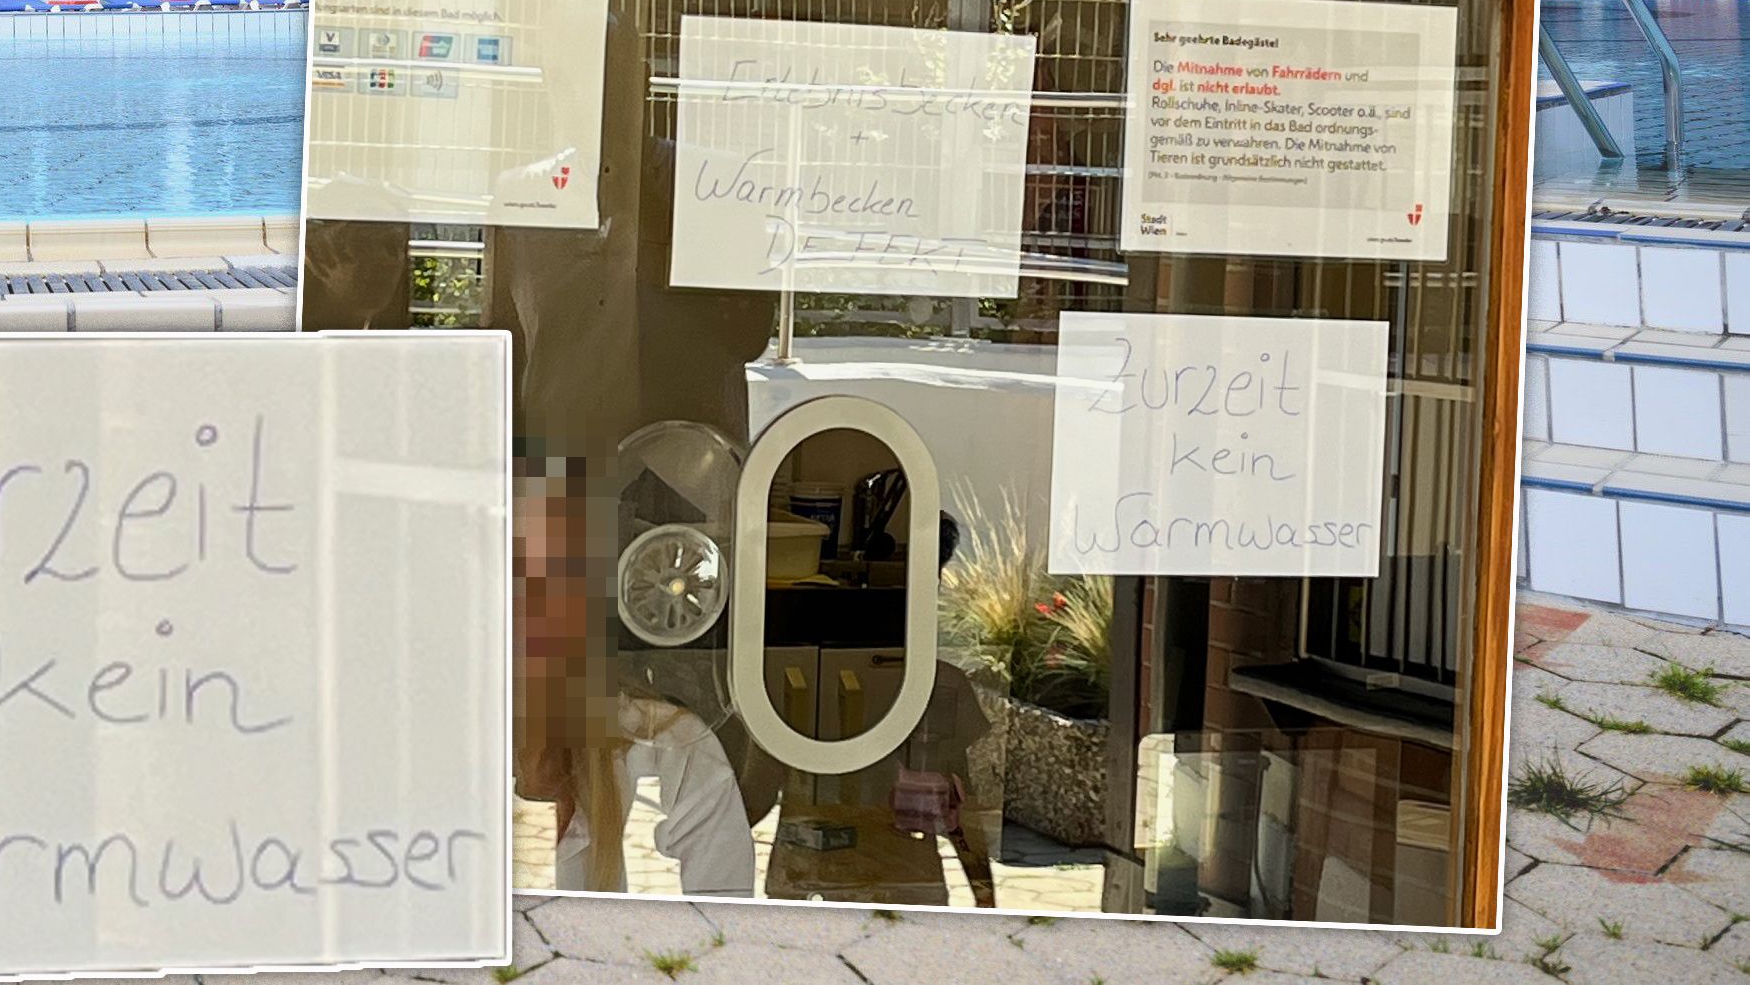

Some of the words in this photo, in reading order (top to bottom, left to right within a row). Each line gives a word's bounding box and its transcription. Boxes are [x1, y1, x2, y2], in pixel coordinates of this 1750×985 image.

[1154, 32, 1176, 43] Sehr
[1179, 34, 1220, 46] geehrte
[1222, 35, 1279, 49] Badegäste!
[1153, 60, 1174, 73] Die
[1177, 61, 1243, 77] Mitnahme
[1246, 68, 1269, 78] von
[1272, 66, 1342, 81] Fahrrädern
[1345, 70, 1369, 83] und
[1153, 81, 1176, 94] dgl.
[1179, 81, 1194, 92] ist
[1197, 81, 1229, 93] nicht
[1231, 83, 1281, 96] erlaubt.
[1152, 96, 1221, 113] Rollschuhe,
[1225, 98, 1304, 117] Inline-Skater,
[1308, 102, 1354, 117] Scooter
[1385, 106, 1411, 120] sind
[1150, 118, 1171, 127] vor
[1174, 116, 1202, 128] dem
[1205, 117, 1247, 130] Eintritt
[1250, 119, 1261, 130] in
[1264, 119, 1286, 132] das
[1289, 120, 1312, 133] Bad
[1315, 122, 1378, 136] ordnungs-
[850, 131, 868, 146] +
[1150, 133, 1193, 148] gemäß
[1196, 138, 1209, 147] zu
[1214, 136, 1282, 151] verwahren.
[1285, 137, 1305, 151] Die
[1308, 139, 1371, 154] Mitnahme
[1374, 144, 1397, 154] von
[1150, 150, 1188, 165] Tieren
[1191, 151, 1205, 164] ist
[1208, 152, 1291, 168] grundsätzlich
[1294, 156, 1324, 169] nicht
[1328, 159, 1387, 173] gestattet.
[694, 148, 921, 218] Warmbecken
[1141, 213, 1167, 225] Stadt
[1141, 225, 1167, 236] Wien
[1088, 337, 1300, 417] Zurzeit
[1170, 432, 1296, 481] kein
[1074, 492, 1372, 556] Warmwasser
